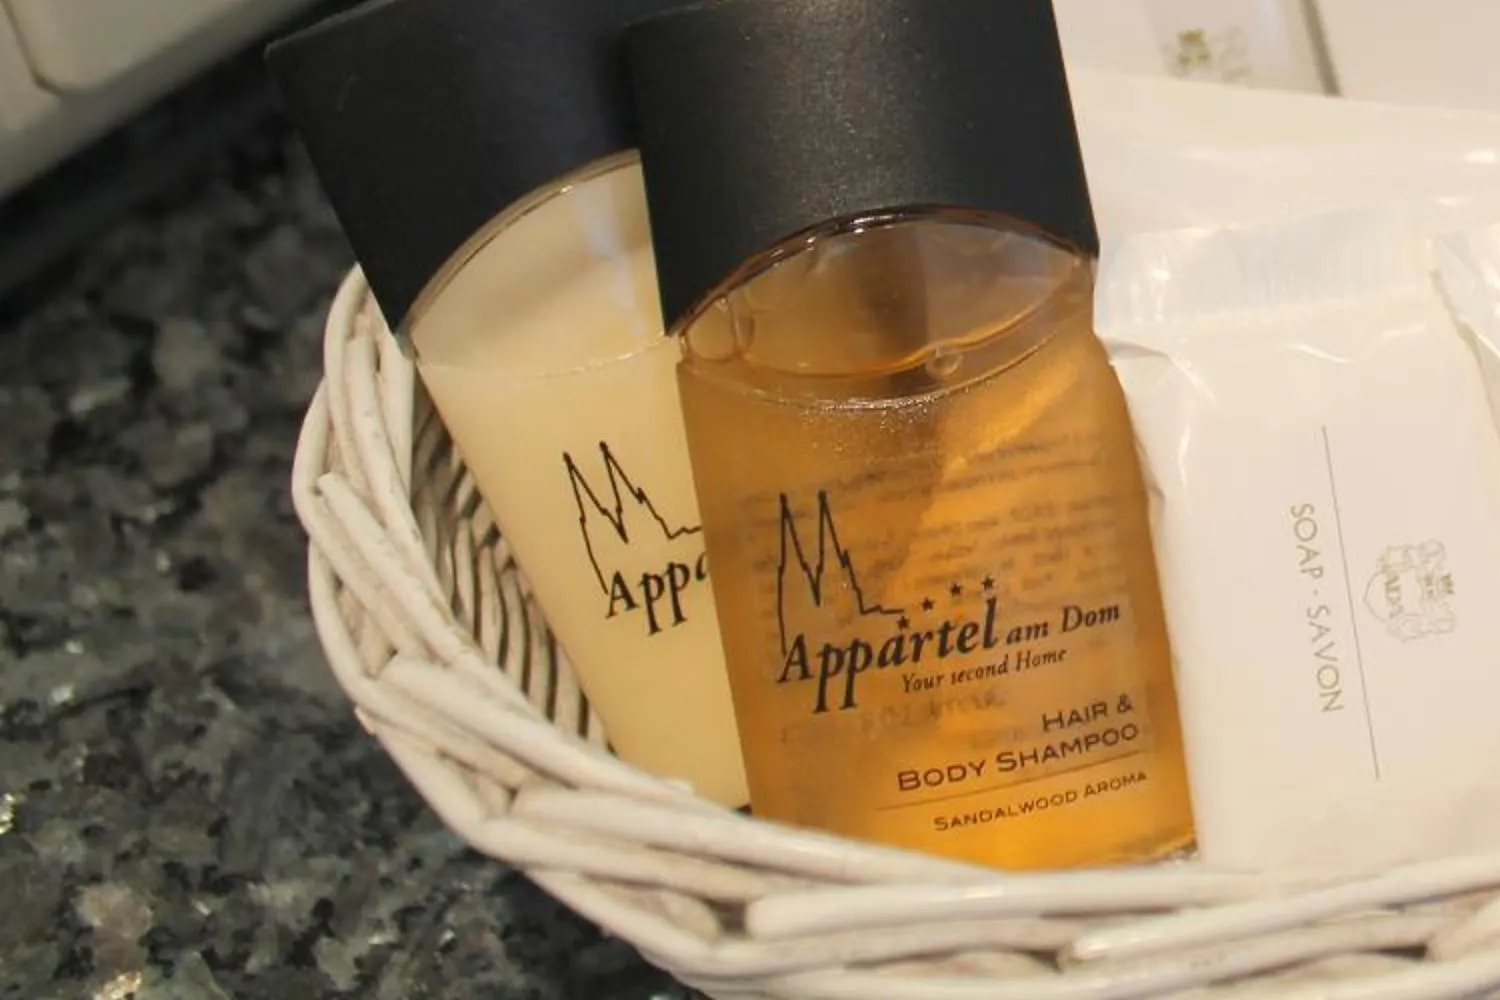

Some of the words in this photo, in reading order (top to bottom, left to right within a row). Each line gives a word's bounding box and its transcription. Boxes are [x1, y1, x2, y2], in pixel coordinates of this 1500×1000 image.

[1290, 503, 1324, 579] SOAP
[1006, 619, 1050, 646] am
[1061, 603, 1121, 634] Dom
[902, 671, 945, 695] Your
[950, 653, 1009, 687] second
[1015, 647, 1068, 672] Home
[1306, 604, 1346, 713] SAVON
[1042, 700, 1109, 733] HAIR
[1117, 692, 1135, 714] &
[897, 759, 987, 792] BODY
[995, 722, 1140, 773] SHAMPOO
[933, 791, 1078, 832] SANDALWOOD
[1084, 770, 1148, 798] AROMA
